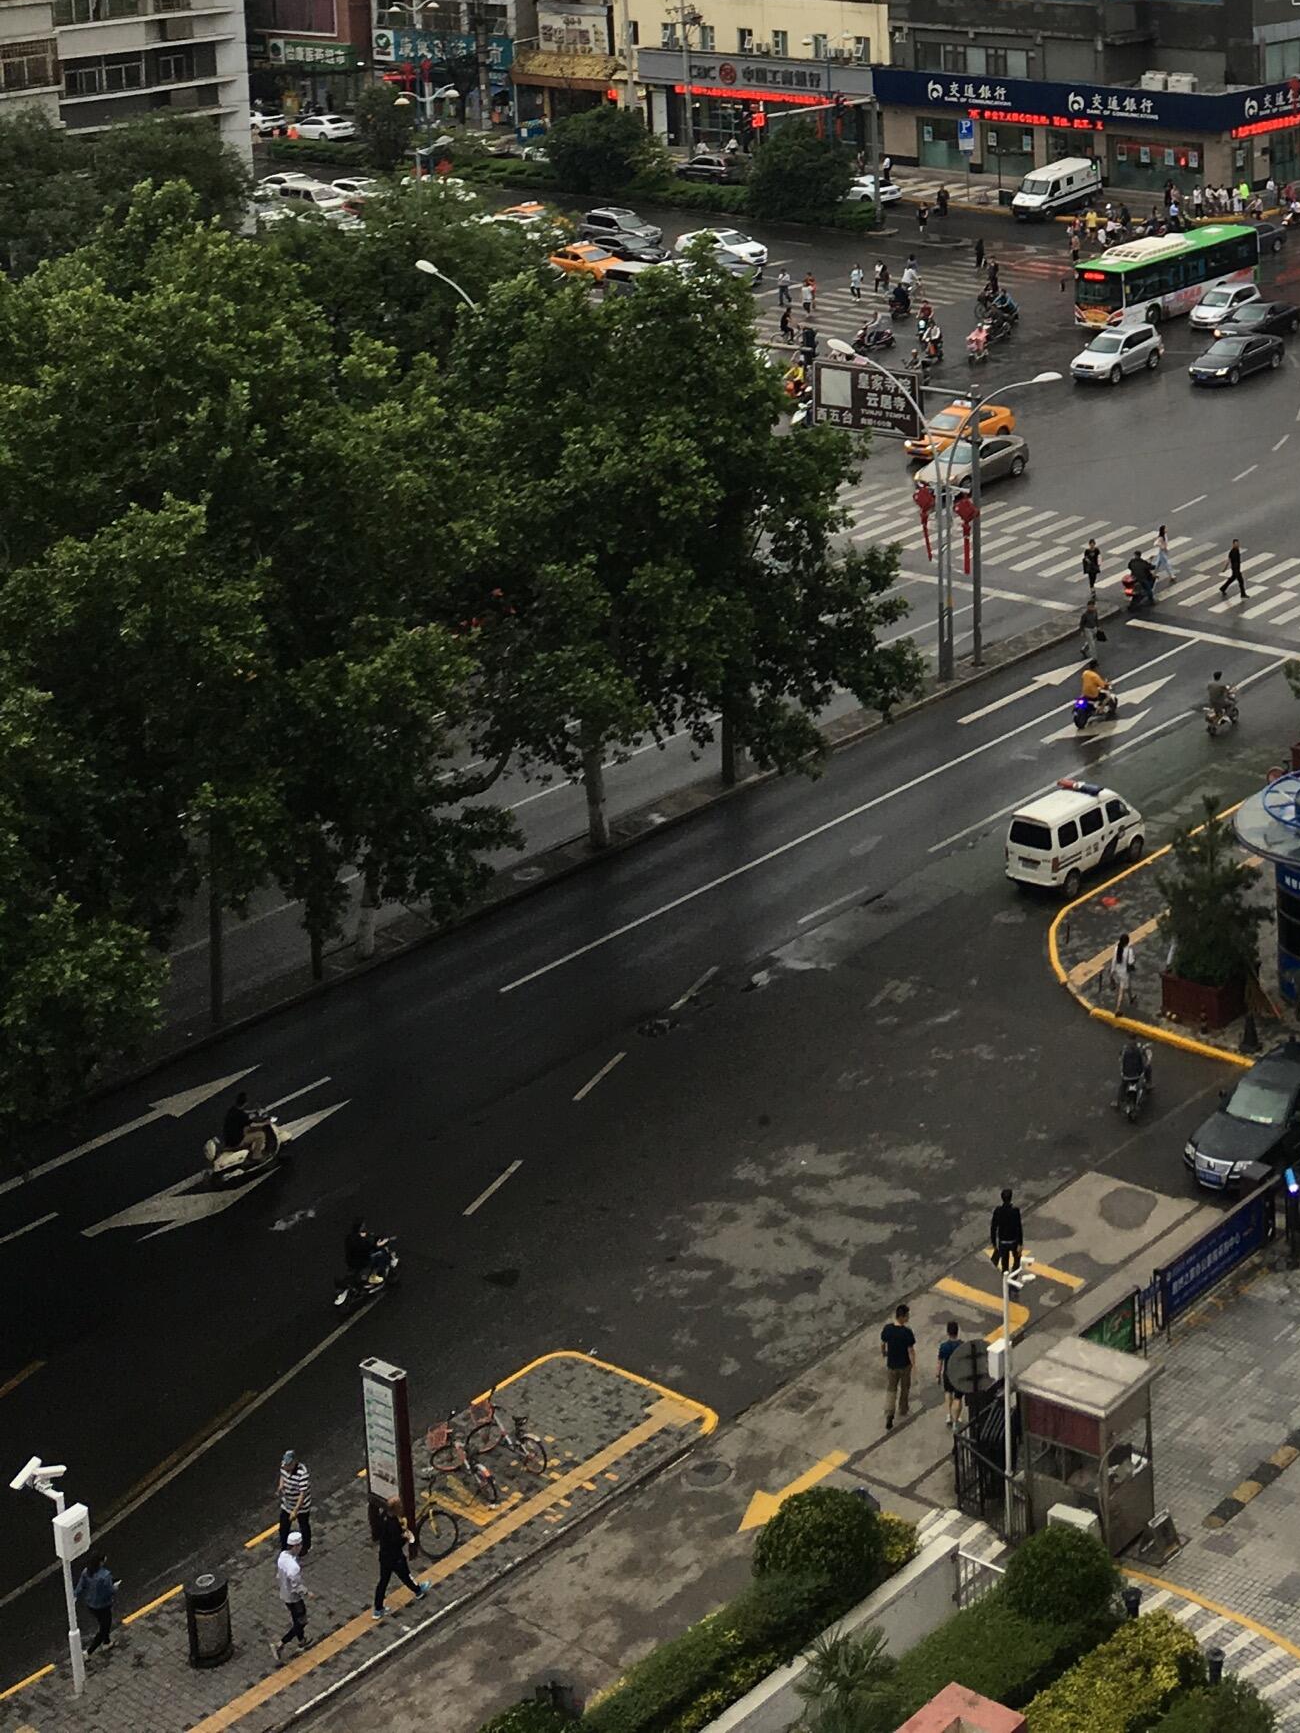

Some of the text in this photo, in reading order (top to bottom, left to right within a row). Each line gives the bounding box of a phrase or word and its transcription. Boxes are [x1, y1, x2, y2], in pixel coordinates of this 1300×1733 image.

[961, 120, 971, 134] P
[866, 392, 906, 412] 云居寺
[816, 407, 854, 425] 西五台
